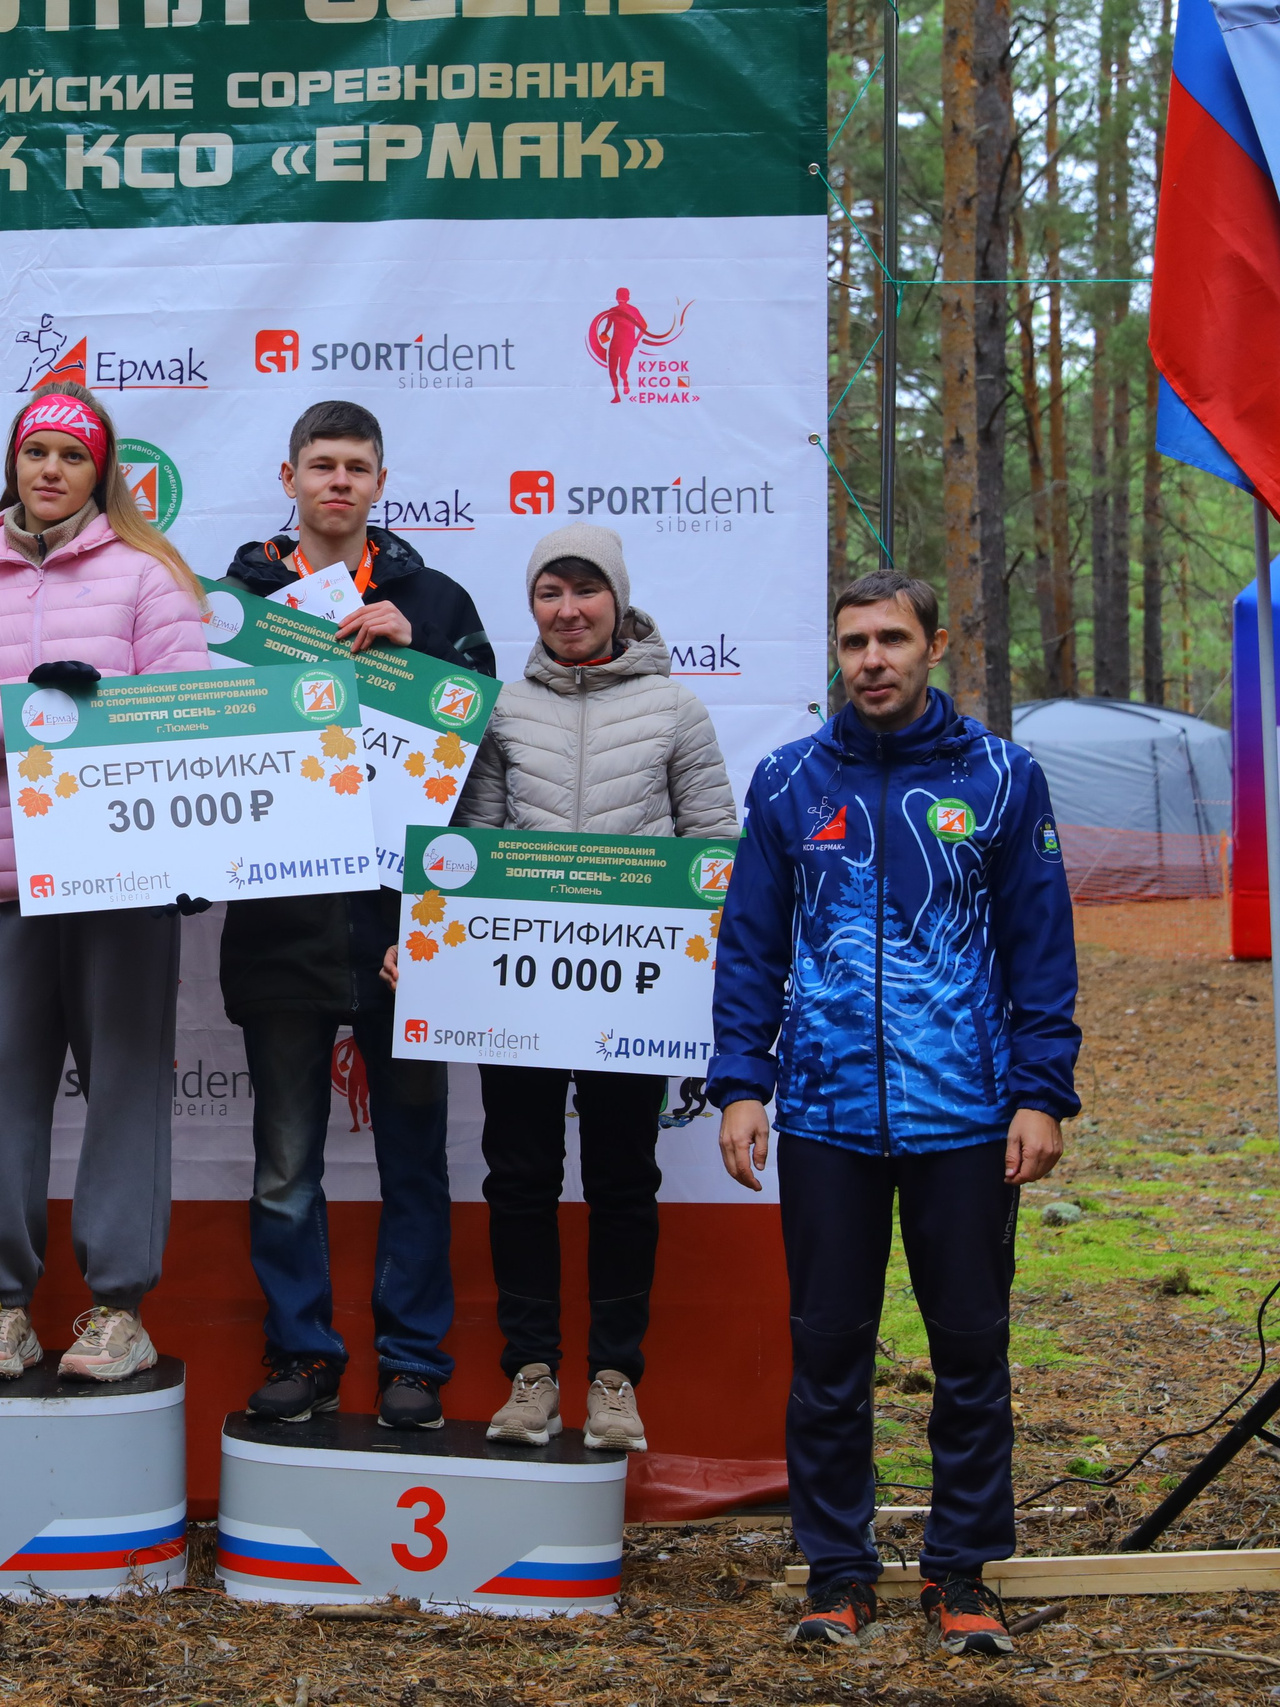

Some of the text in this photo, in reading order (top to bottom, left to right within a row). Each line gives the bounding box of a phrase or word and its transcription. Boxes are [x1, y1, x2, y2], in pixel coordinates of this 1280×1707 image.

[226, 61, 665, 109] СОРЕВНОВАНИЯ
[65, 132, 233, 189] КСО
[271, 121, 664, 182] «ЕРМАК»
[311, 333, 515, 371] SPORTident
[97, 348, 208, 391] Ермак
[638, 361, 689, 372] КУБОК
[398, 373, 473, 389] siberia
[638, 377, 671, 388] КСО
[629, 392, 700, 404] «ЕРМАК»
[117, 444, 160, 461] ОРТИВНОГО
[568, 476, 774, 515] SPORTident
[656, 517, 732, 533] siberia
[256, 619, 414, 681] ПО СПОРТИВНОМУ ОРИЕНТИРОВАНИЮ
[671, 634, 740, 671] мак
[264, 638, 397, 692] ЗОЛОТАЯ 2026
[89, 688, 268, 708] ПО СПОРТИВНОМУ ОРИЕНТИРОВАНИЮ
[95, 678, 255, 698] ВСЕРОССИЙСКИЕ СОРЕВНОВАНИЯ
[46, 712, 79, 725] Ермак
[108, 710, 168, 723] ЗОЛОТАЯ
[224, 703, 256, 715] 2026
[156, 723, 209, 733] г.Тюмень
[79, 750, 295, 787] СЕРТИФИКАТ
[108, 798, 155, 832] 30
[498, 841, 655, 856] ВСЕРОССИЙСКИЕ СОРЕВНОВАНИЯ
[445, 860, 477, 874] Ермак
[491, 851, 667, 867] ПО СПОРТИВНОМУ ОРИЕНТИРОВАНИЮ
[248, 856, 369, 884] ДОМИНТЕР
[506, 867, 565, 879] ЗОЛОТАЯ
[620, 872, 651, 884] 2026
[61, 871, 170, 896] SPORTident
[550, 884, 602, 895] г.Тюмень
[109, 891, 150, 902] siberia
[468, 916, 683, 949] СЕРТИФИКАТ
[493, 953, 536, 988] 10
[551, 957, 621, 993] 000
[434, 1028, 539, 1050] SPORTident
[615, 1037, 713, 1061] ДОМИНТ
[478, 1047, 518, 1059] siberia
[173, 1101, 228, 1116] beria
[392, 1486, 449, 1572] 3
